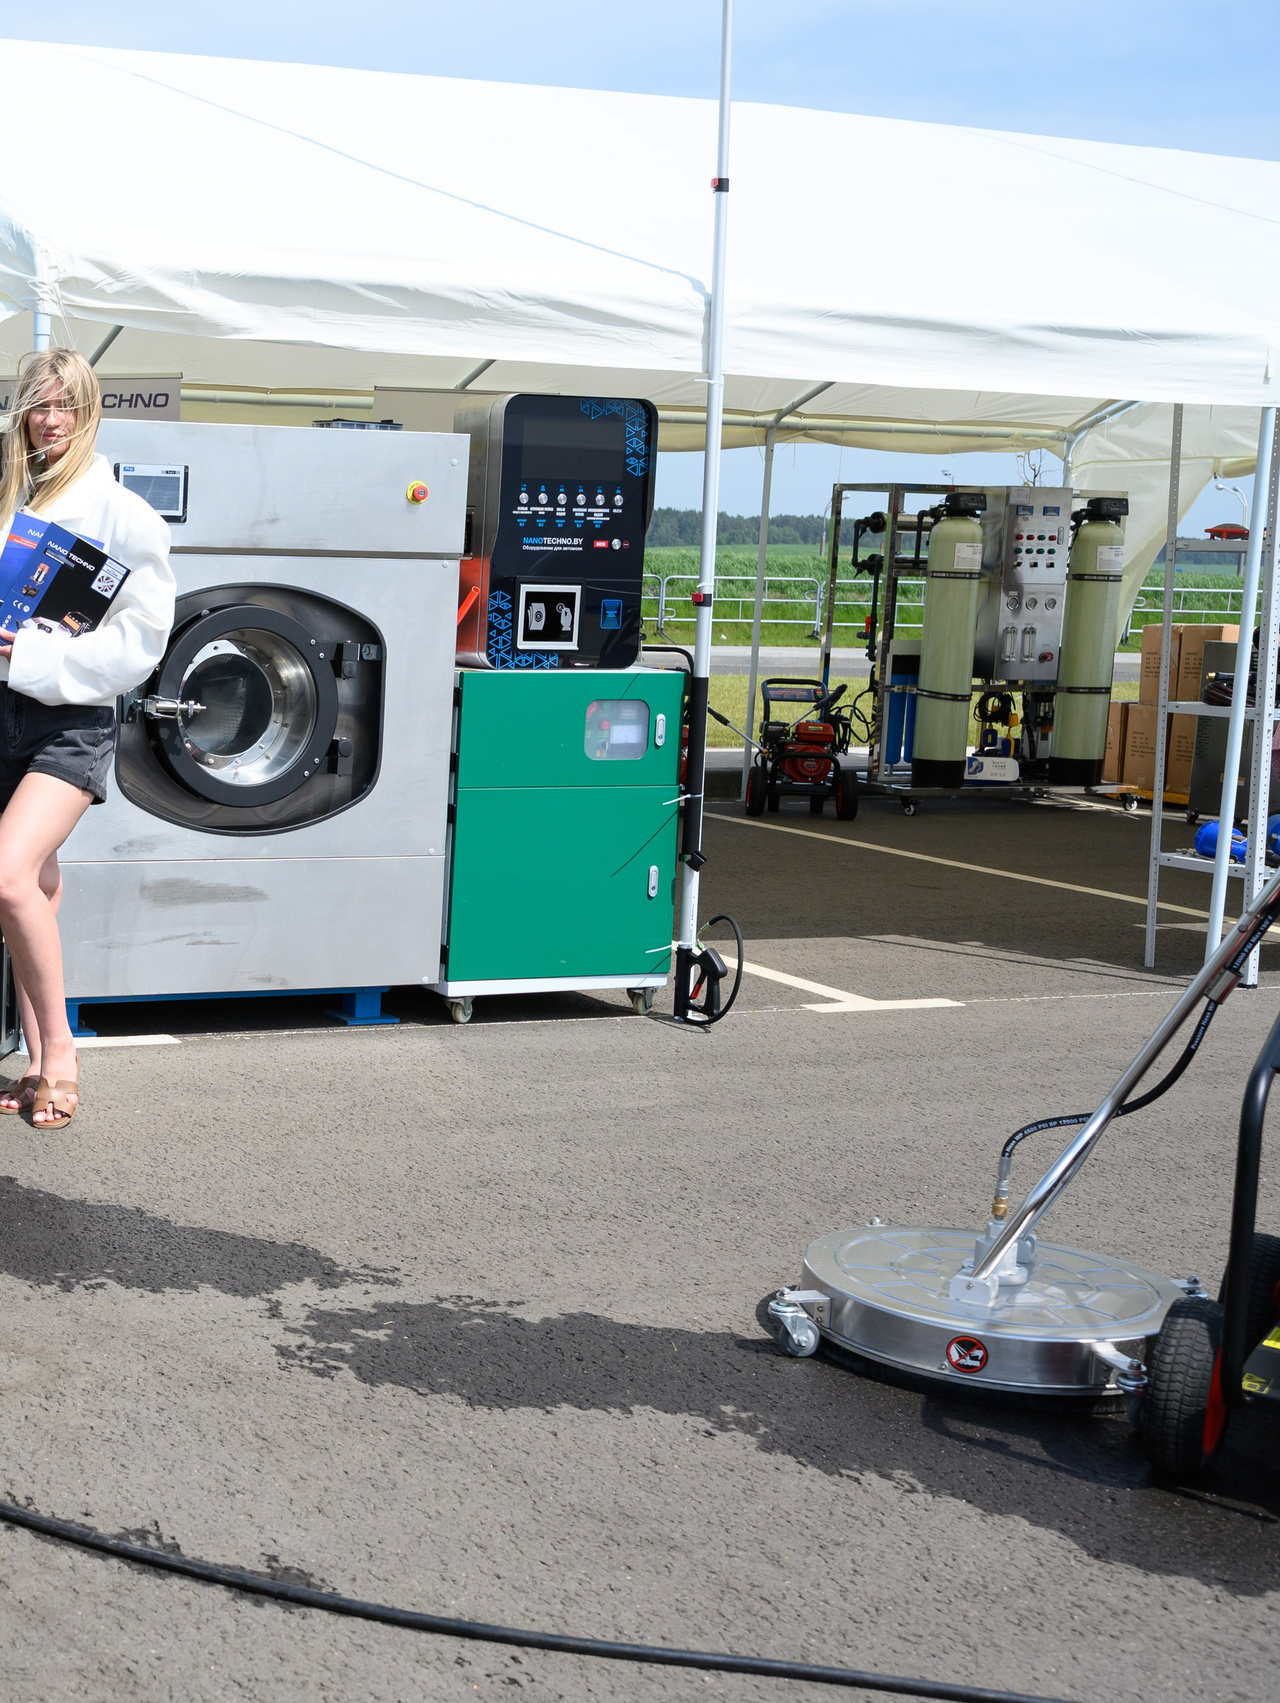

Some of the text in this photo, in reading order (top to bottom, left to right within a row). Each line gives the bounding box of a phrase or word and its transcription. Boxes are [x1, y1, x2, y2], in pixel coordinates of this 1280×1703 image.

[47, 540, 69, 556] NANO
[68, 552, 96, 572] TECHNO
[523, 537, 584, 545] NANOTECHNO.BY
[1191, 1026, 1205, 1050] Pressure
[1201, 1011, 1211, 1026] Hose
